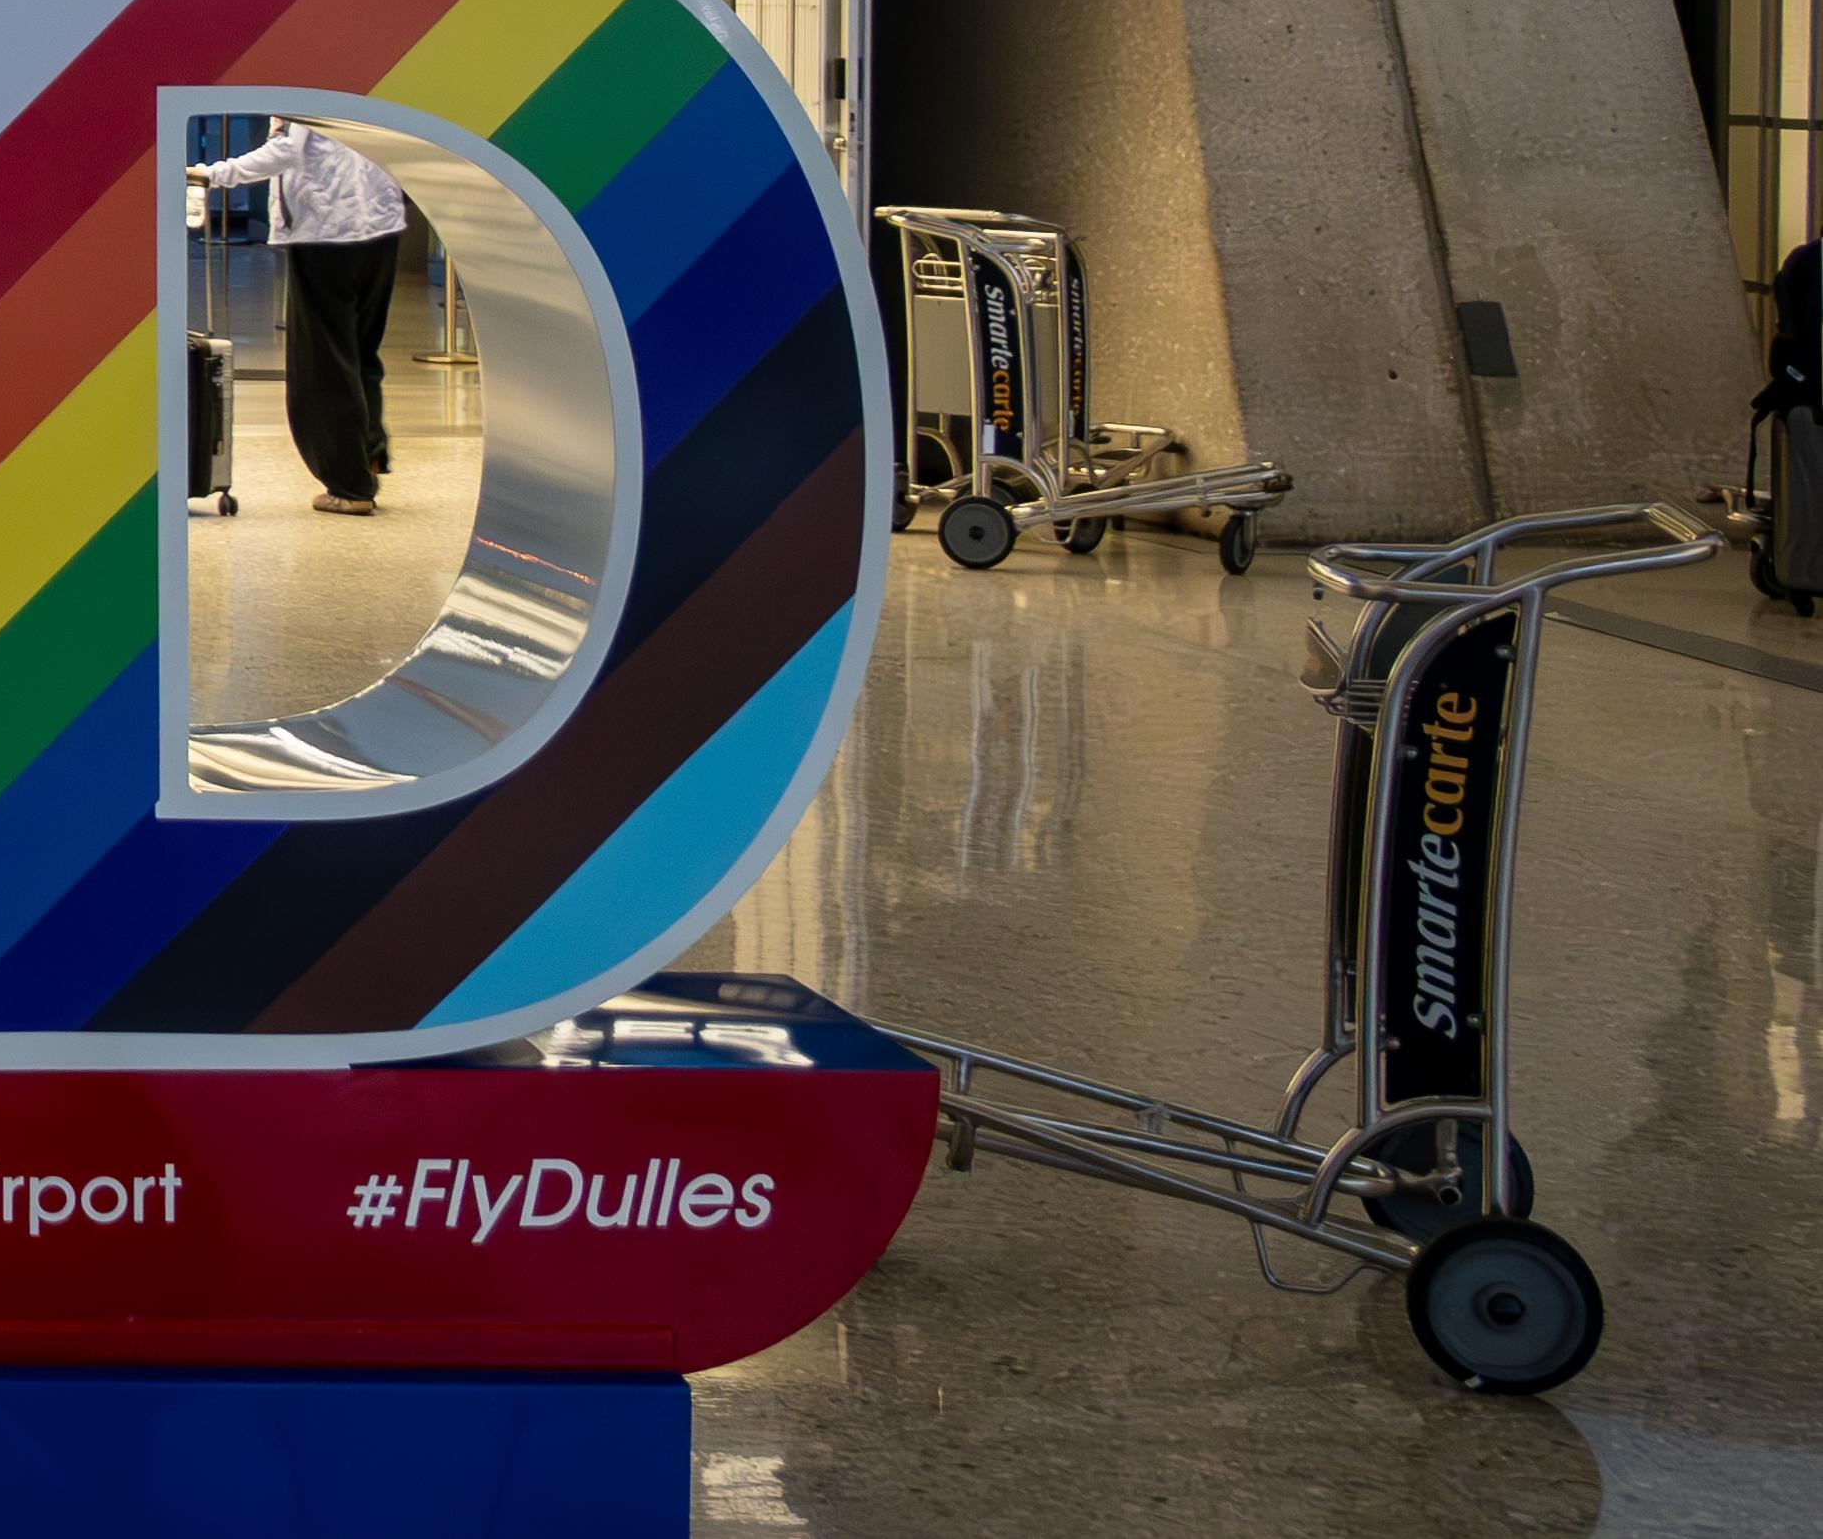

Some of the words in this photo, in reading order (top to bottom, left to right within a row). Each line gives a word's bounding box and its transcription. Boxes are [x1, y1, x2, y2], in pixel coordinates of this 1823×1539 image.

[984, 283, 1015, 432] smartecarte
[1409, 691, 1478, 1039] smartecarte
[346, 1158, 775, 1244] #FlyDulles
